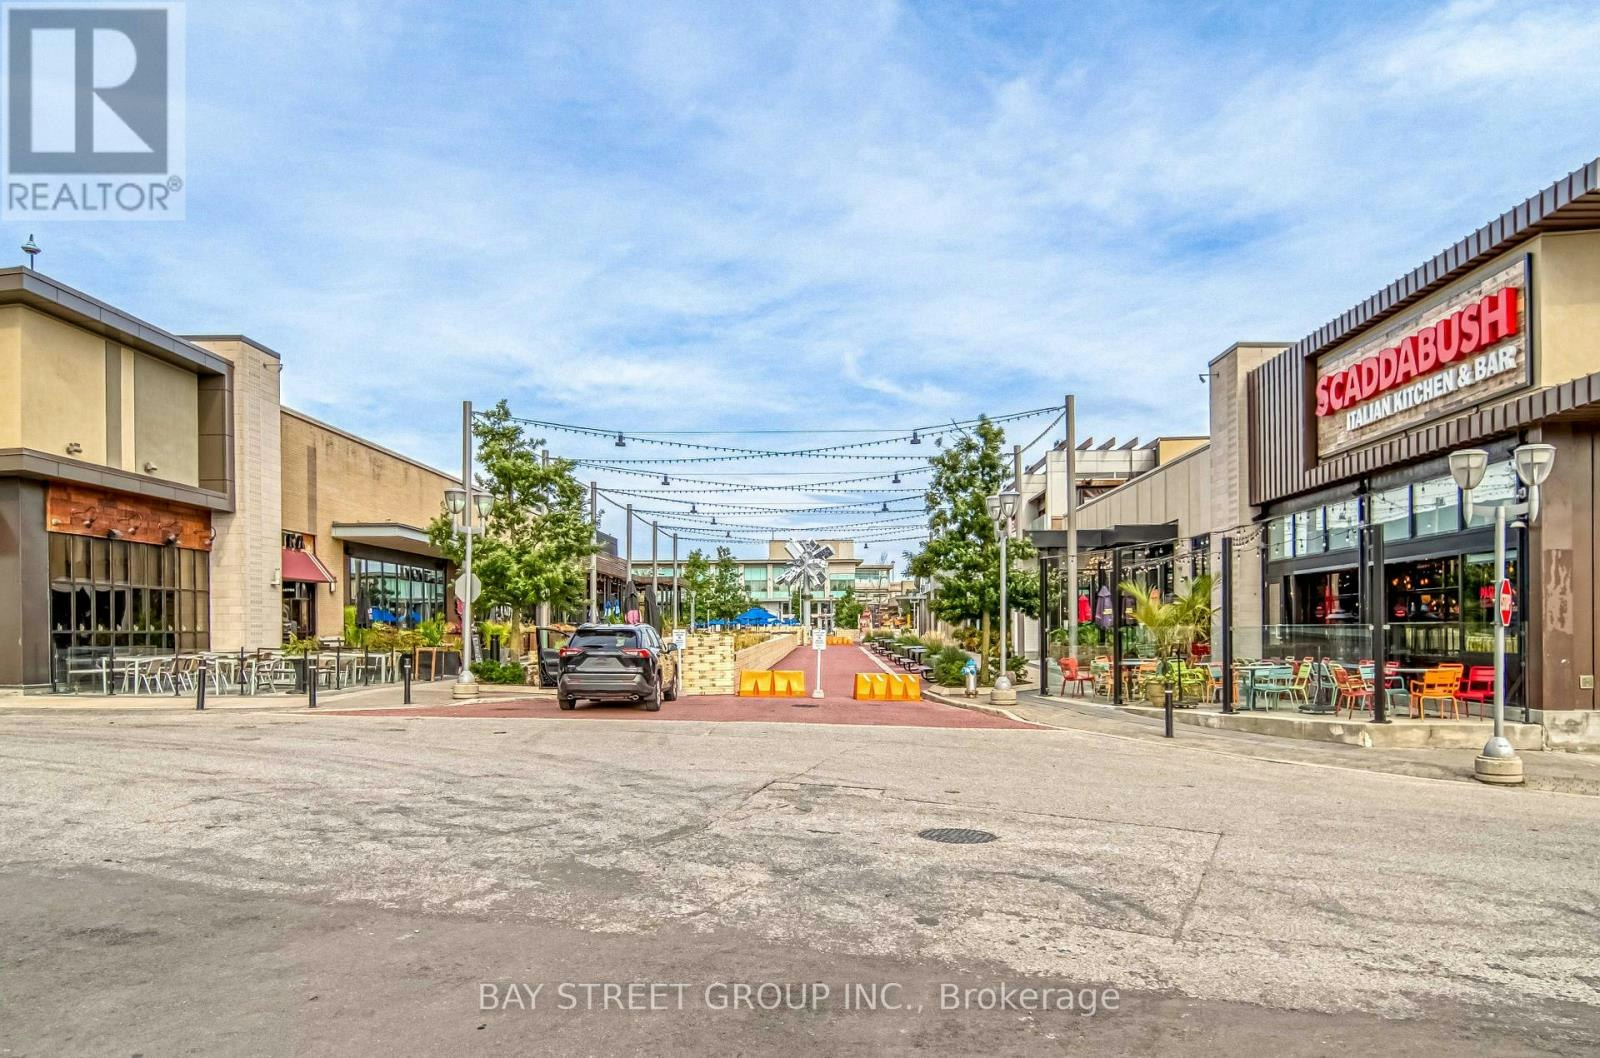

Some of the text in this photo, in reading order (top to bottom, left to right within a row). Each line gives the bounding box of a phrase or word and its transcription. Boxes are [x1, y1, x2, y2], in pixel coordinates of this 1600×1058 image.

[1315, 287, 1518, 417] SCADDABUSH
[1347, 346, 1517, 431] ITALIAN KITCHEN & BAR
